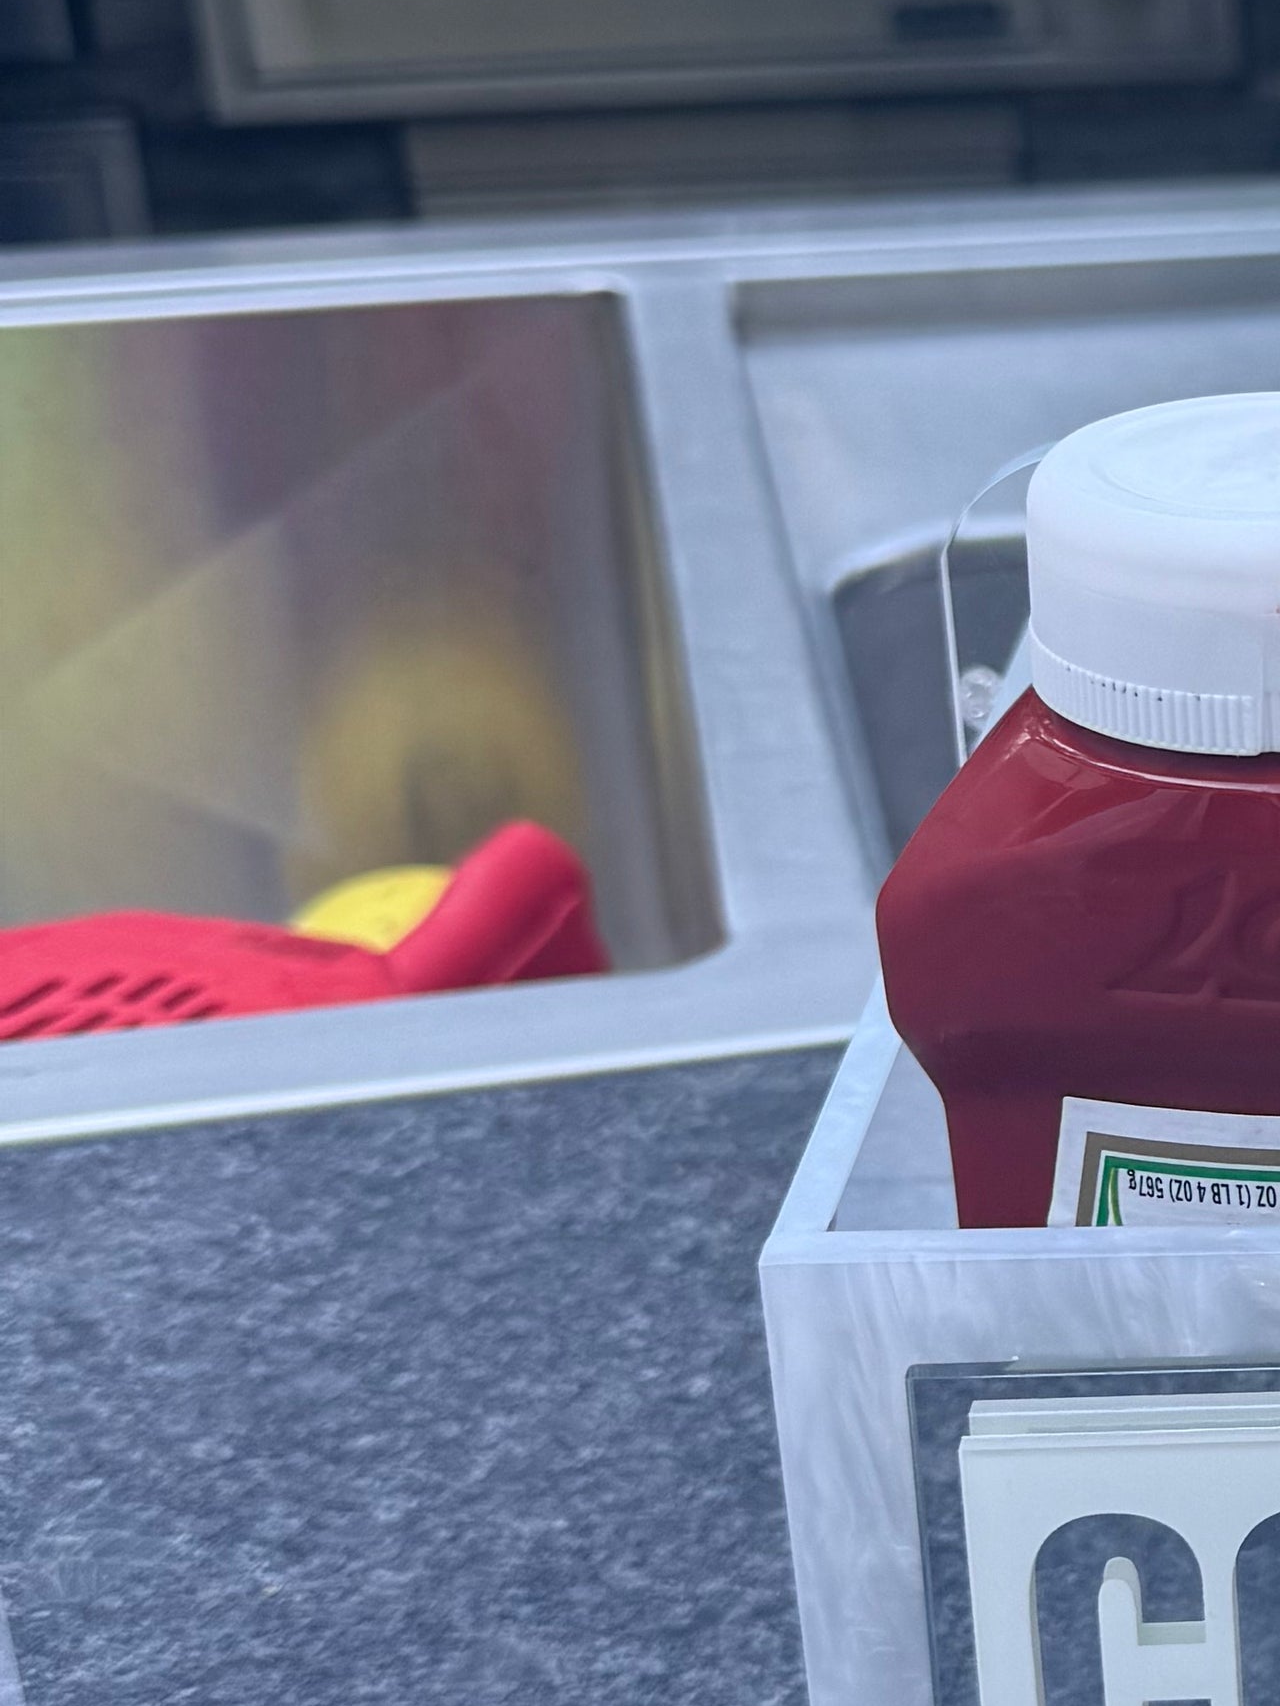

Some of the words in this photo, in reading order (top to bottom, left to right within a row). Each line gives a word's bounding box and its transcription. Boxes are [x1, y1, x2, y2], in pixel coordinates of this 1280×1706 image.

[1127, 1169, 1164, 1199] 567g
[1169, 1178, 1193, 1203] OZ)
[1197, 1181, 1206, 1203] 4
[1211, 1182, 1231, 1205] LB
[1236, 1184, 1252, 1209] (1
[1256, 1185, 1277, 1209] OZ
